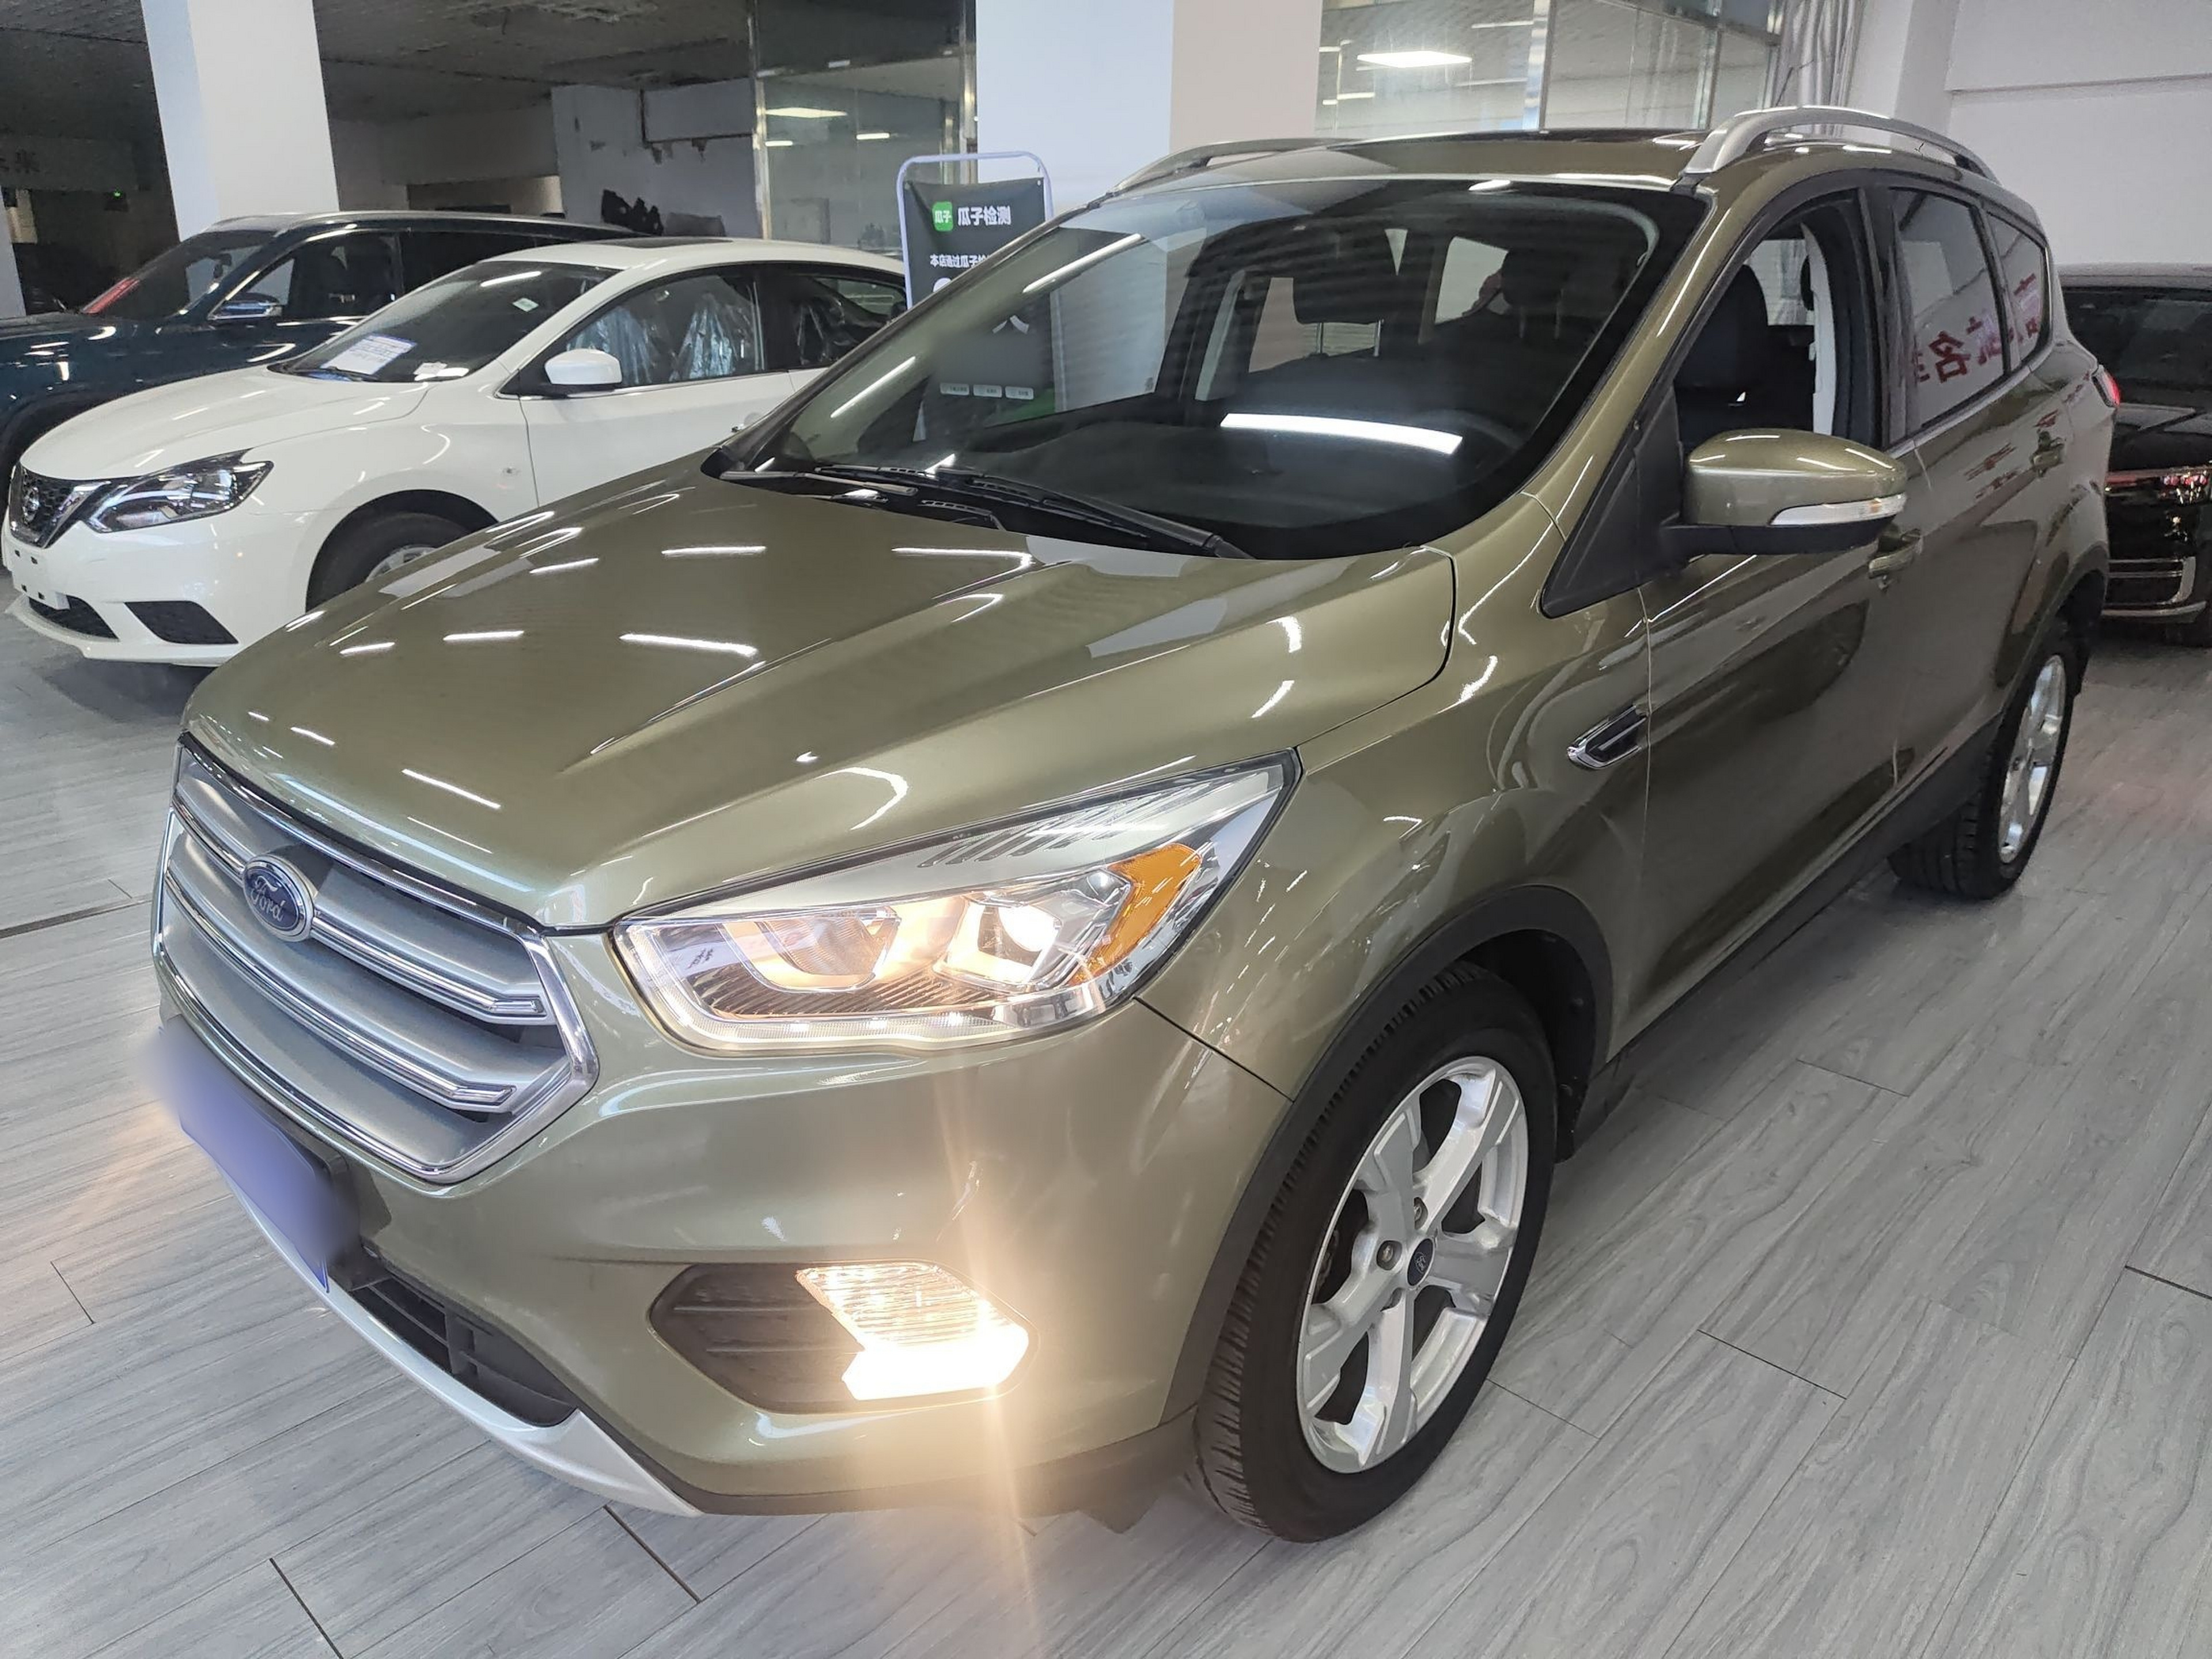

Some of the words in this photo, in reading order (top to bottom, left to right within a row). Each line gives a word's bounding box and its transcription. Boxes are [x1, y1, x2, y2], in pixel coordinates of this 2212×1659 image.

[934, 210, 951, 223] 瓜子
[957, 206, 1012, 226] 瓜子检测
[250, 875, 286, 922] Ford
